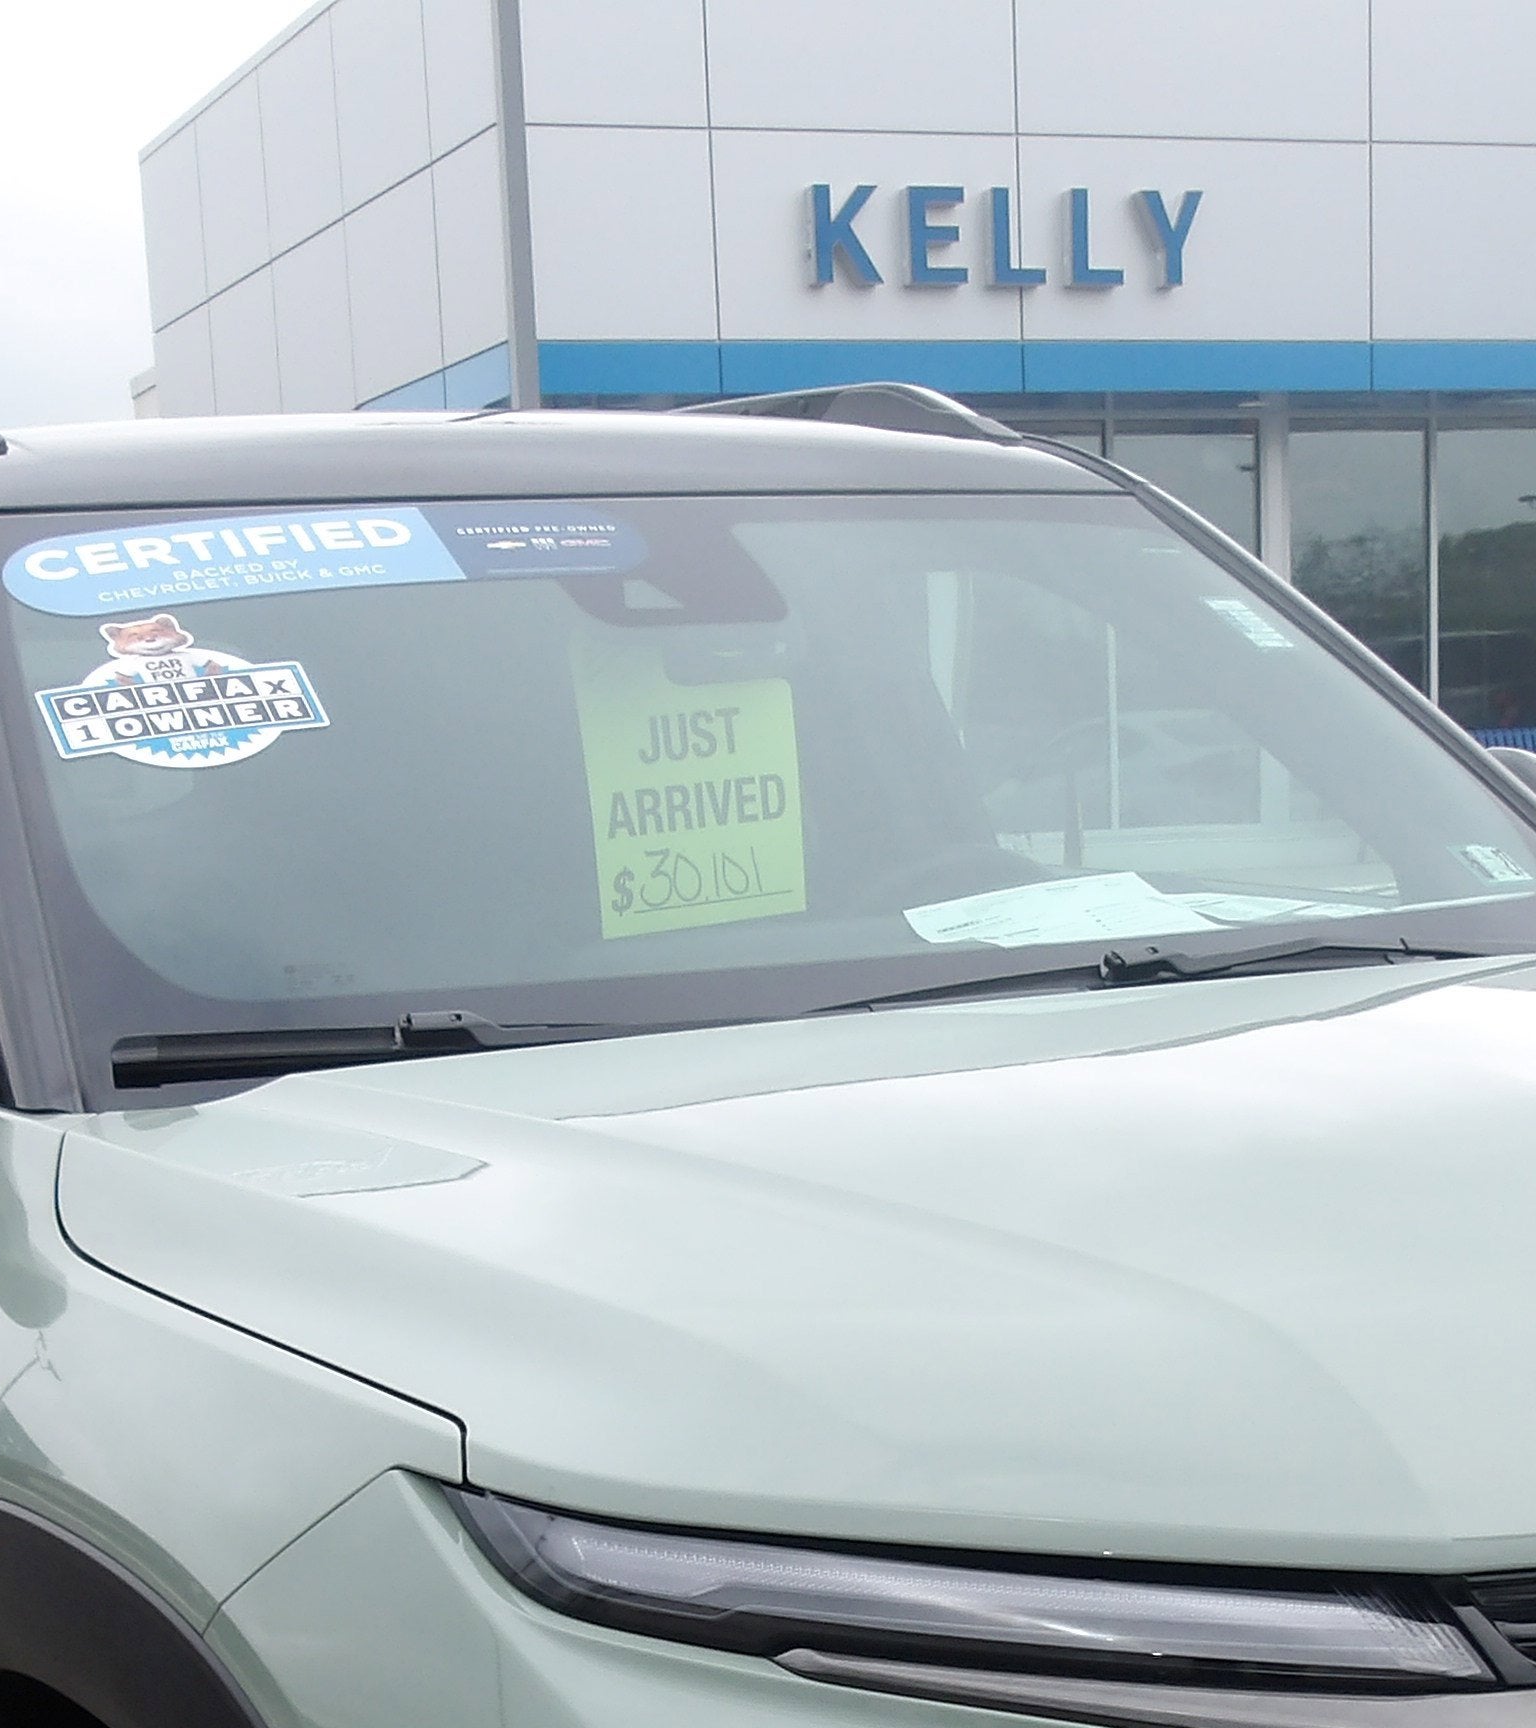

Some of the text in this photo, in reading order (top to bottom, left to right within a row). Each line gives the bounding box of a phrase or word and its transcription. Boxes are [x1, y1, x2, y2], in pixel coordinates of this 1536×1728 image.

[806, 183, 1204, 290] KELLY
[24, 517, 413, 582] CERTIFIED
[171, 558, 299, 582] BACKED BY
[244, 569, 311, 587] BUICK
[339, 563, 387, 578] GMC
[144, 658, 182, 672] CAR
[151, 668, 186, 681] FOX
[63, 677, 294, 717] CARFAX
[72, 698, 304, 744] 1 OWNER
[638, 706, 741, 765] JUST
[607, 772, 787, 840] ARRIVED
